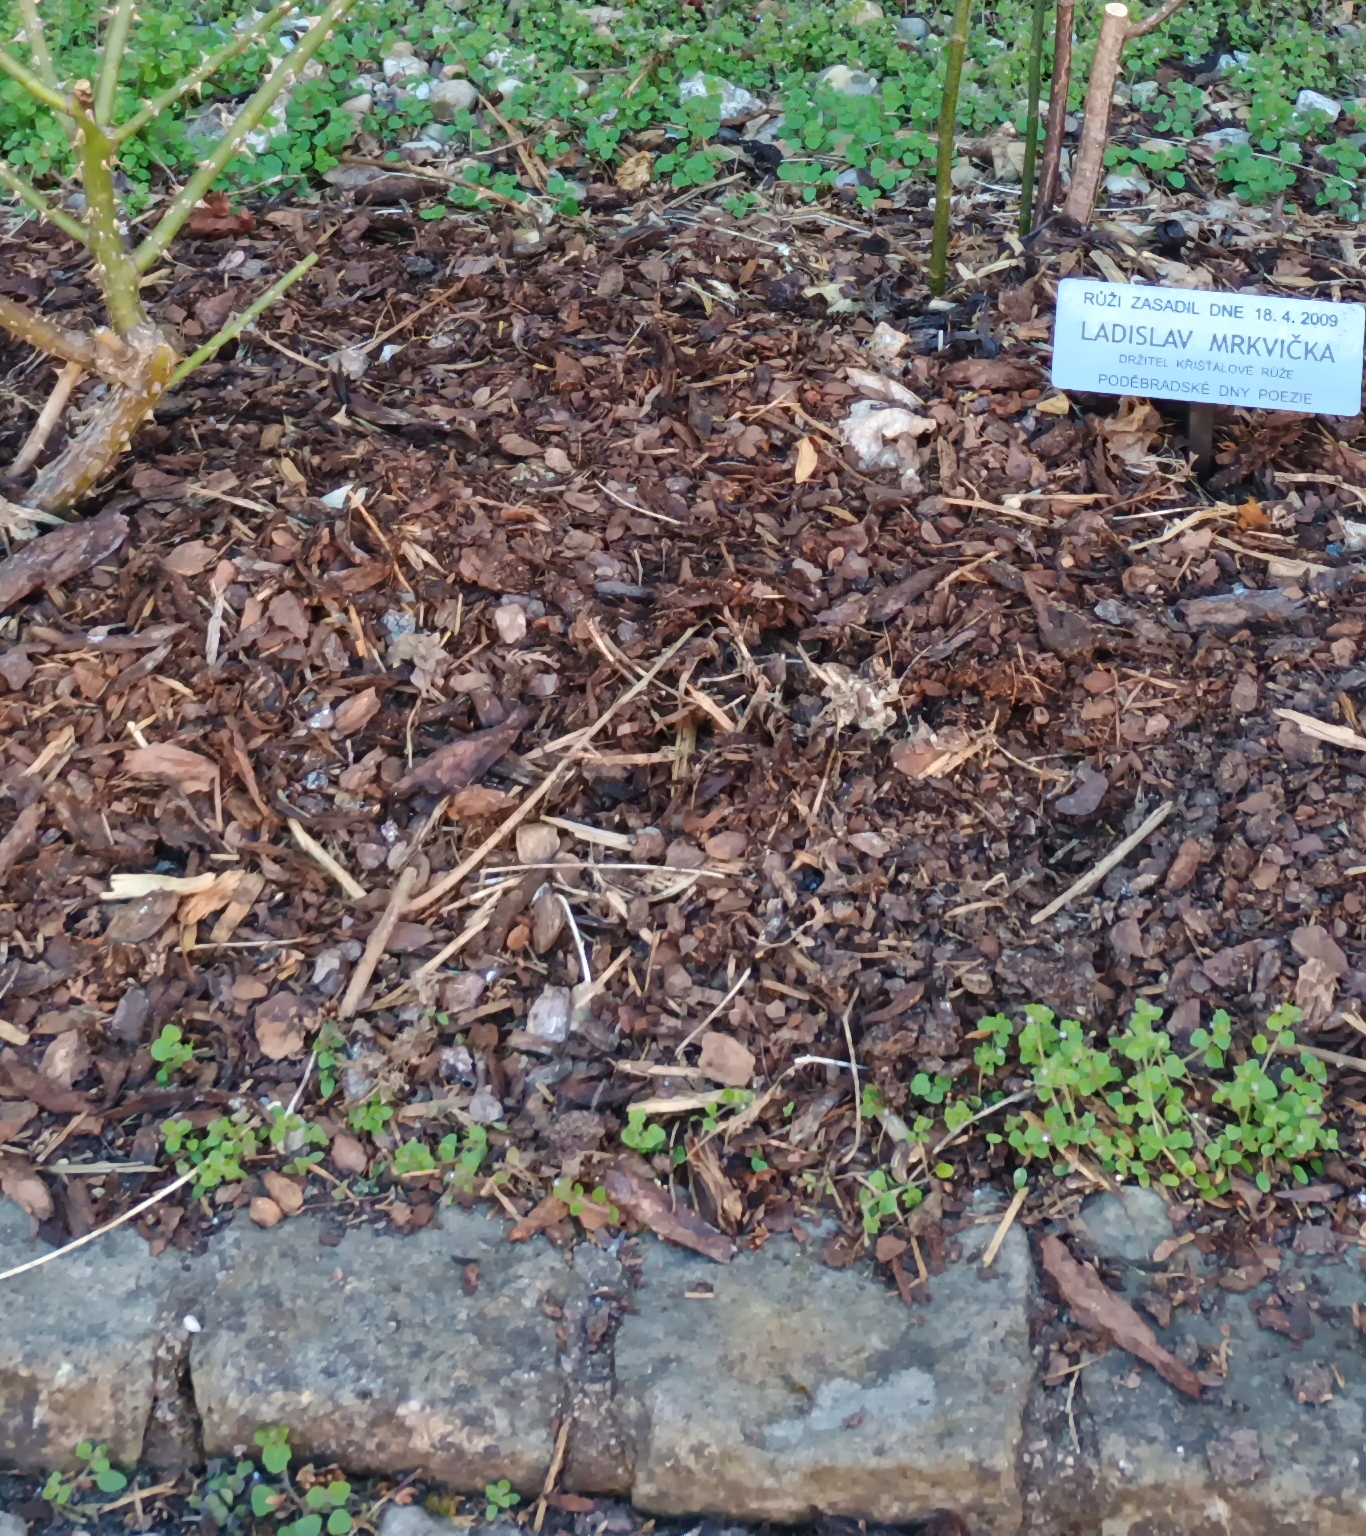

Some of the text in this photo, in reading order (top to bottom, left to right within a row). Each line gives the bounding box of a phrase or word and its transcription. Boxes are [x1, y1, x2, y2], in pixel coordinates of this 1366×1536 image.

[1084, 291, 1121, 307] RŮŽI
[1130, 296, 1200, 315] ZASADIL
[1209, 303, 1244, 319] DNE
[1300, 311, 1339, 327] 2009
[1081, 321, 1335, 363] LADISLAV MRKVIČKA
[1119, 354, 1169, 368] DRŽITEL
[1261, 366, 1295, 380] RŮŽE
[1098, 373, 1313, 405] PODĚBRADSKÉ DNY POEZIE
